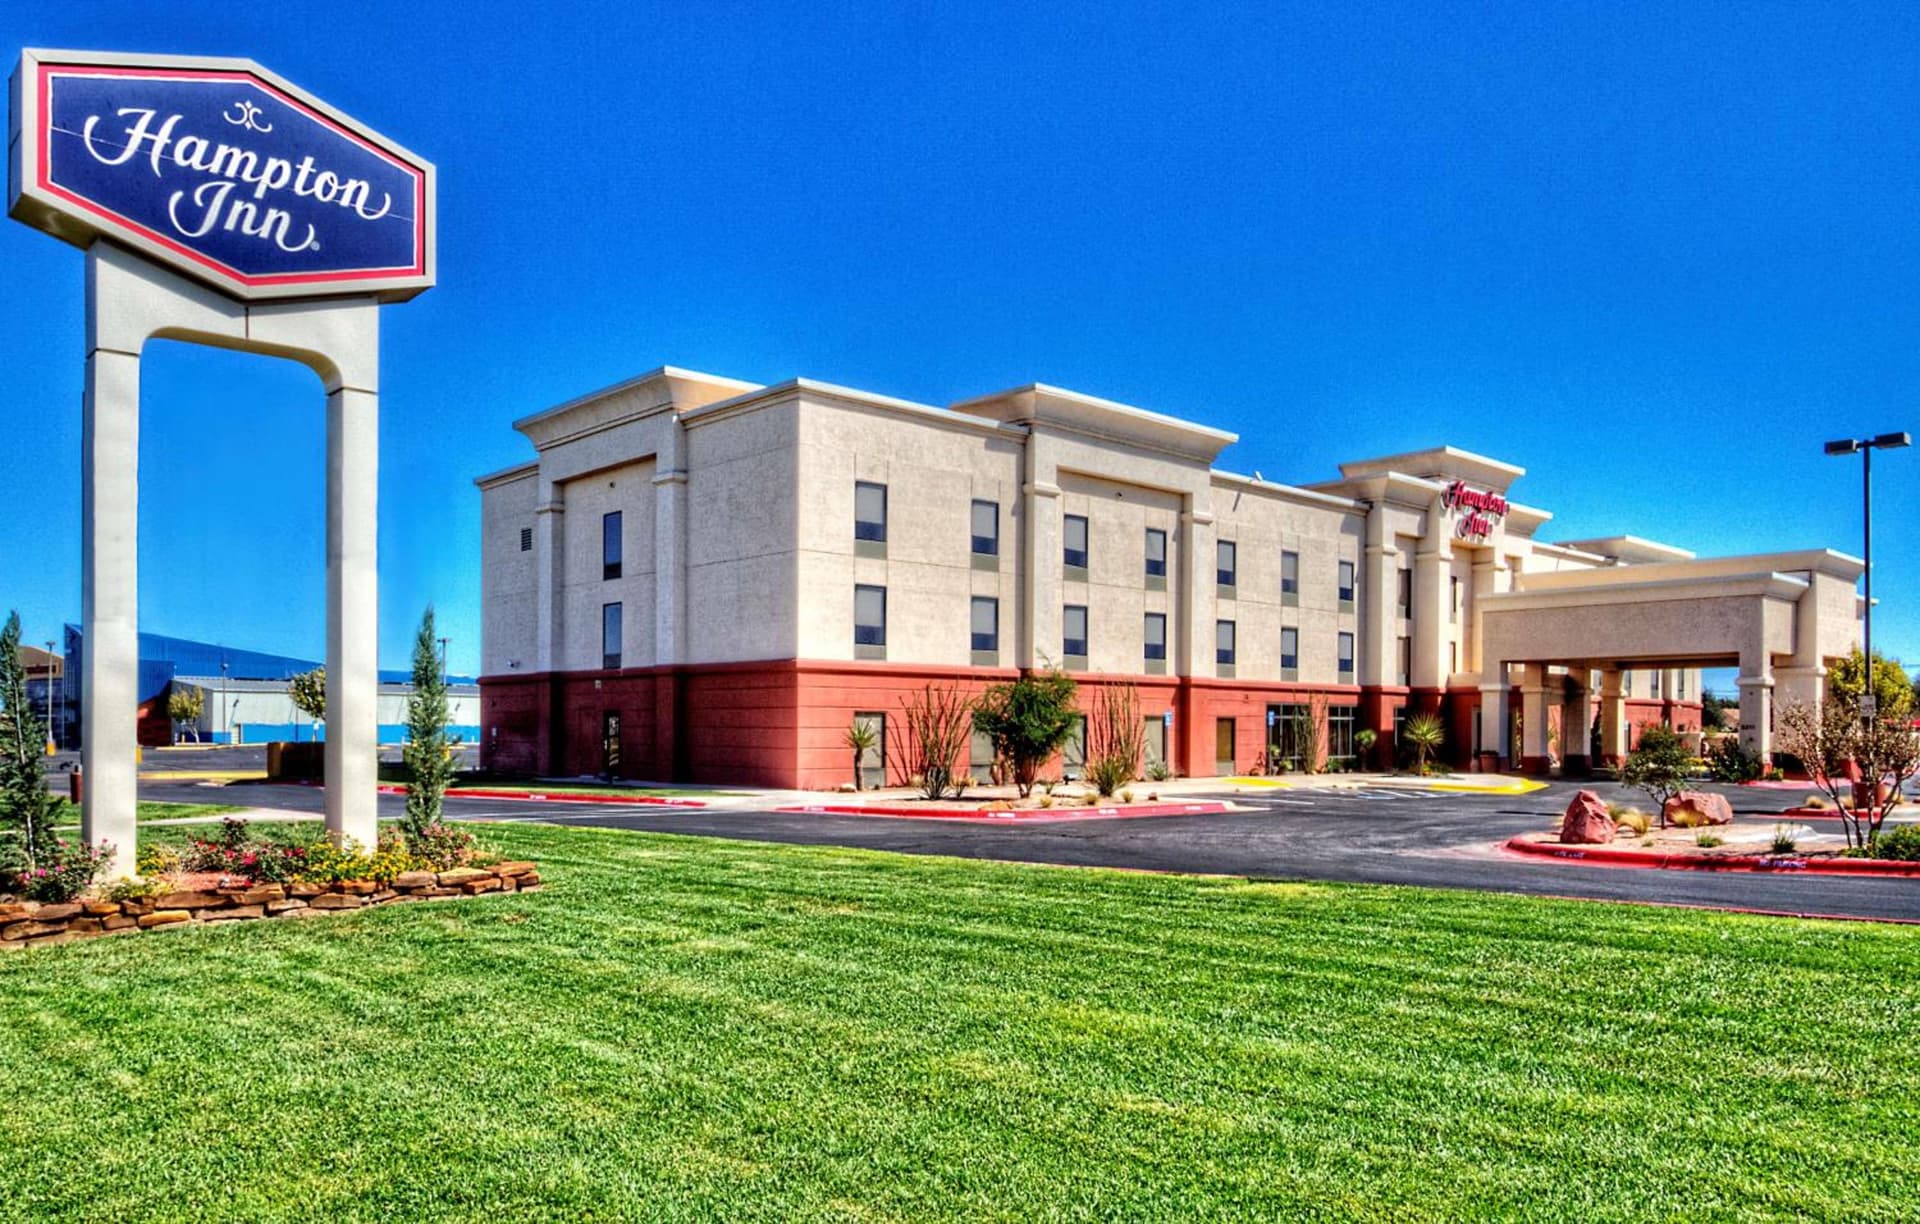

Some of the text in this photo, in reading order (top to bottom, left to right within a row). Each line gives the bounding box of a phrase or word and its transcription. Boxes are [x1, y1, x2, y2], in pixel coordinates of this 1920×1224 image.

[83, 108, 391, 220] Hampton
[169, 181, 315, 252] Inn
[1441, 480, 1509, 516] Hampton
[1456, 512, 1492, 538] Inn
